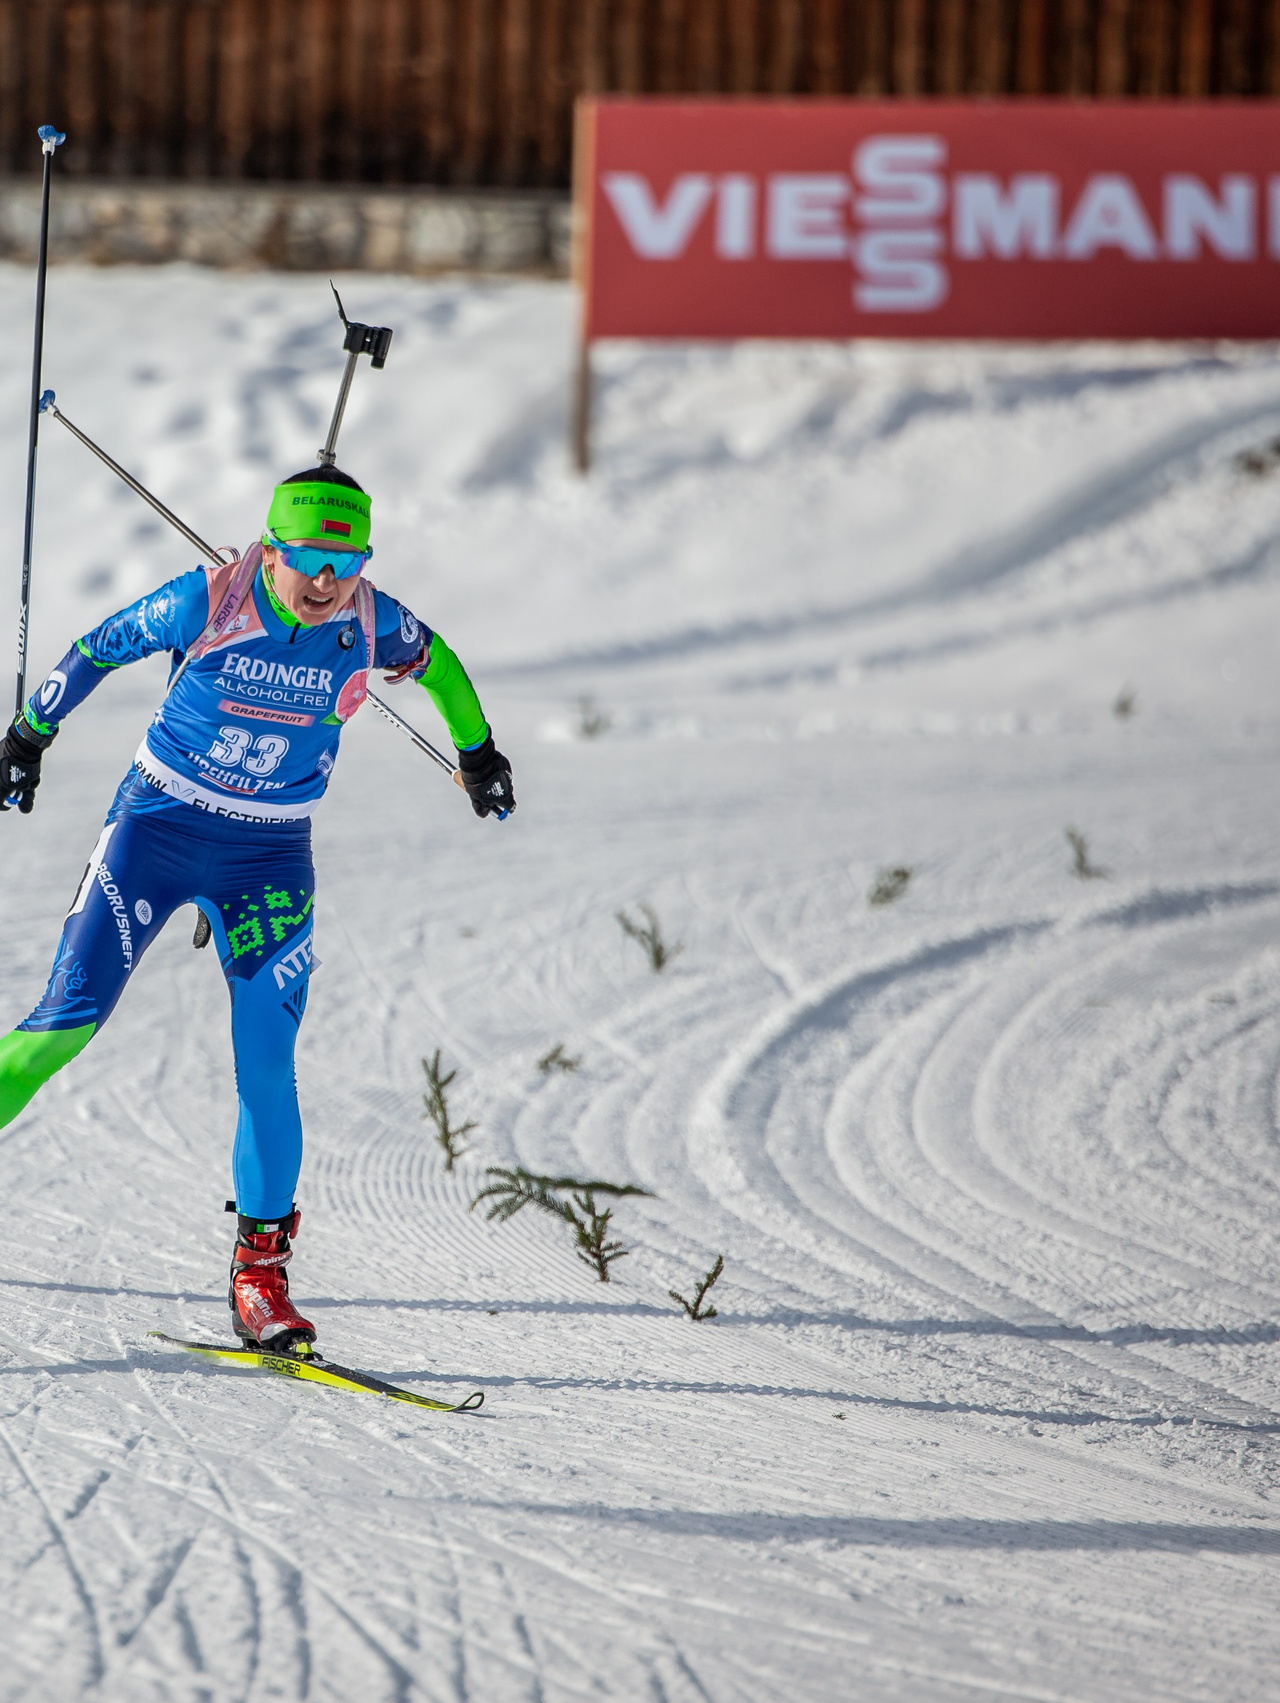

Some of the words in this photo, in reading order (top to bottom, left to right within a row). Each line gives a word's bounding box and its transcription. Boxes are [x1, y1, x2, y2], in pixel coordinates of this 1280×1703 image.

[602, 133, 1280, 313] VIESSMAN
[214, 677, 329, 706] ALKOHOLFREI
[220, 653, 333, 693] ERDINGER
[230, 705, 305, 723] GRAPEFRUIT
[207, 725, 289, 777] 33
[96, 863, 133, 971] BELORUSNEFT
[262, 1357, 301, 1377] FISCHER
